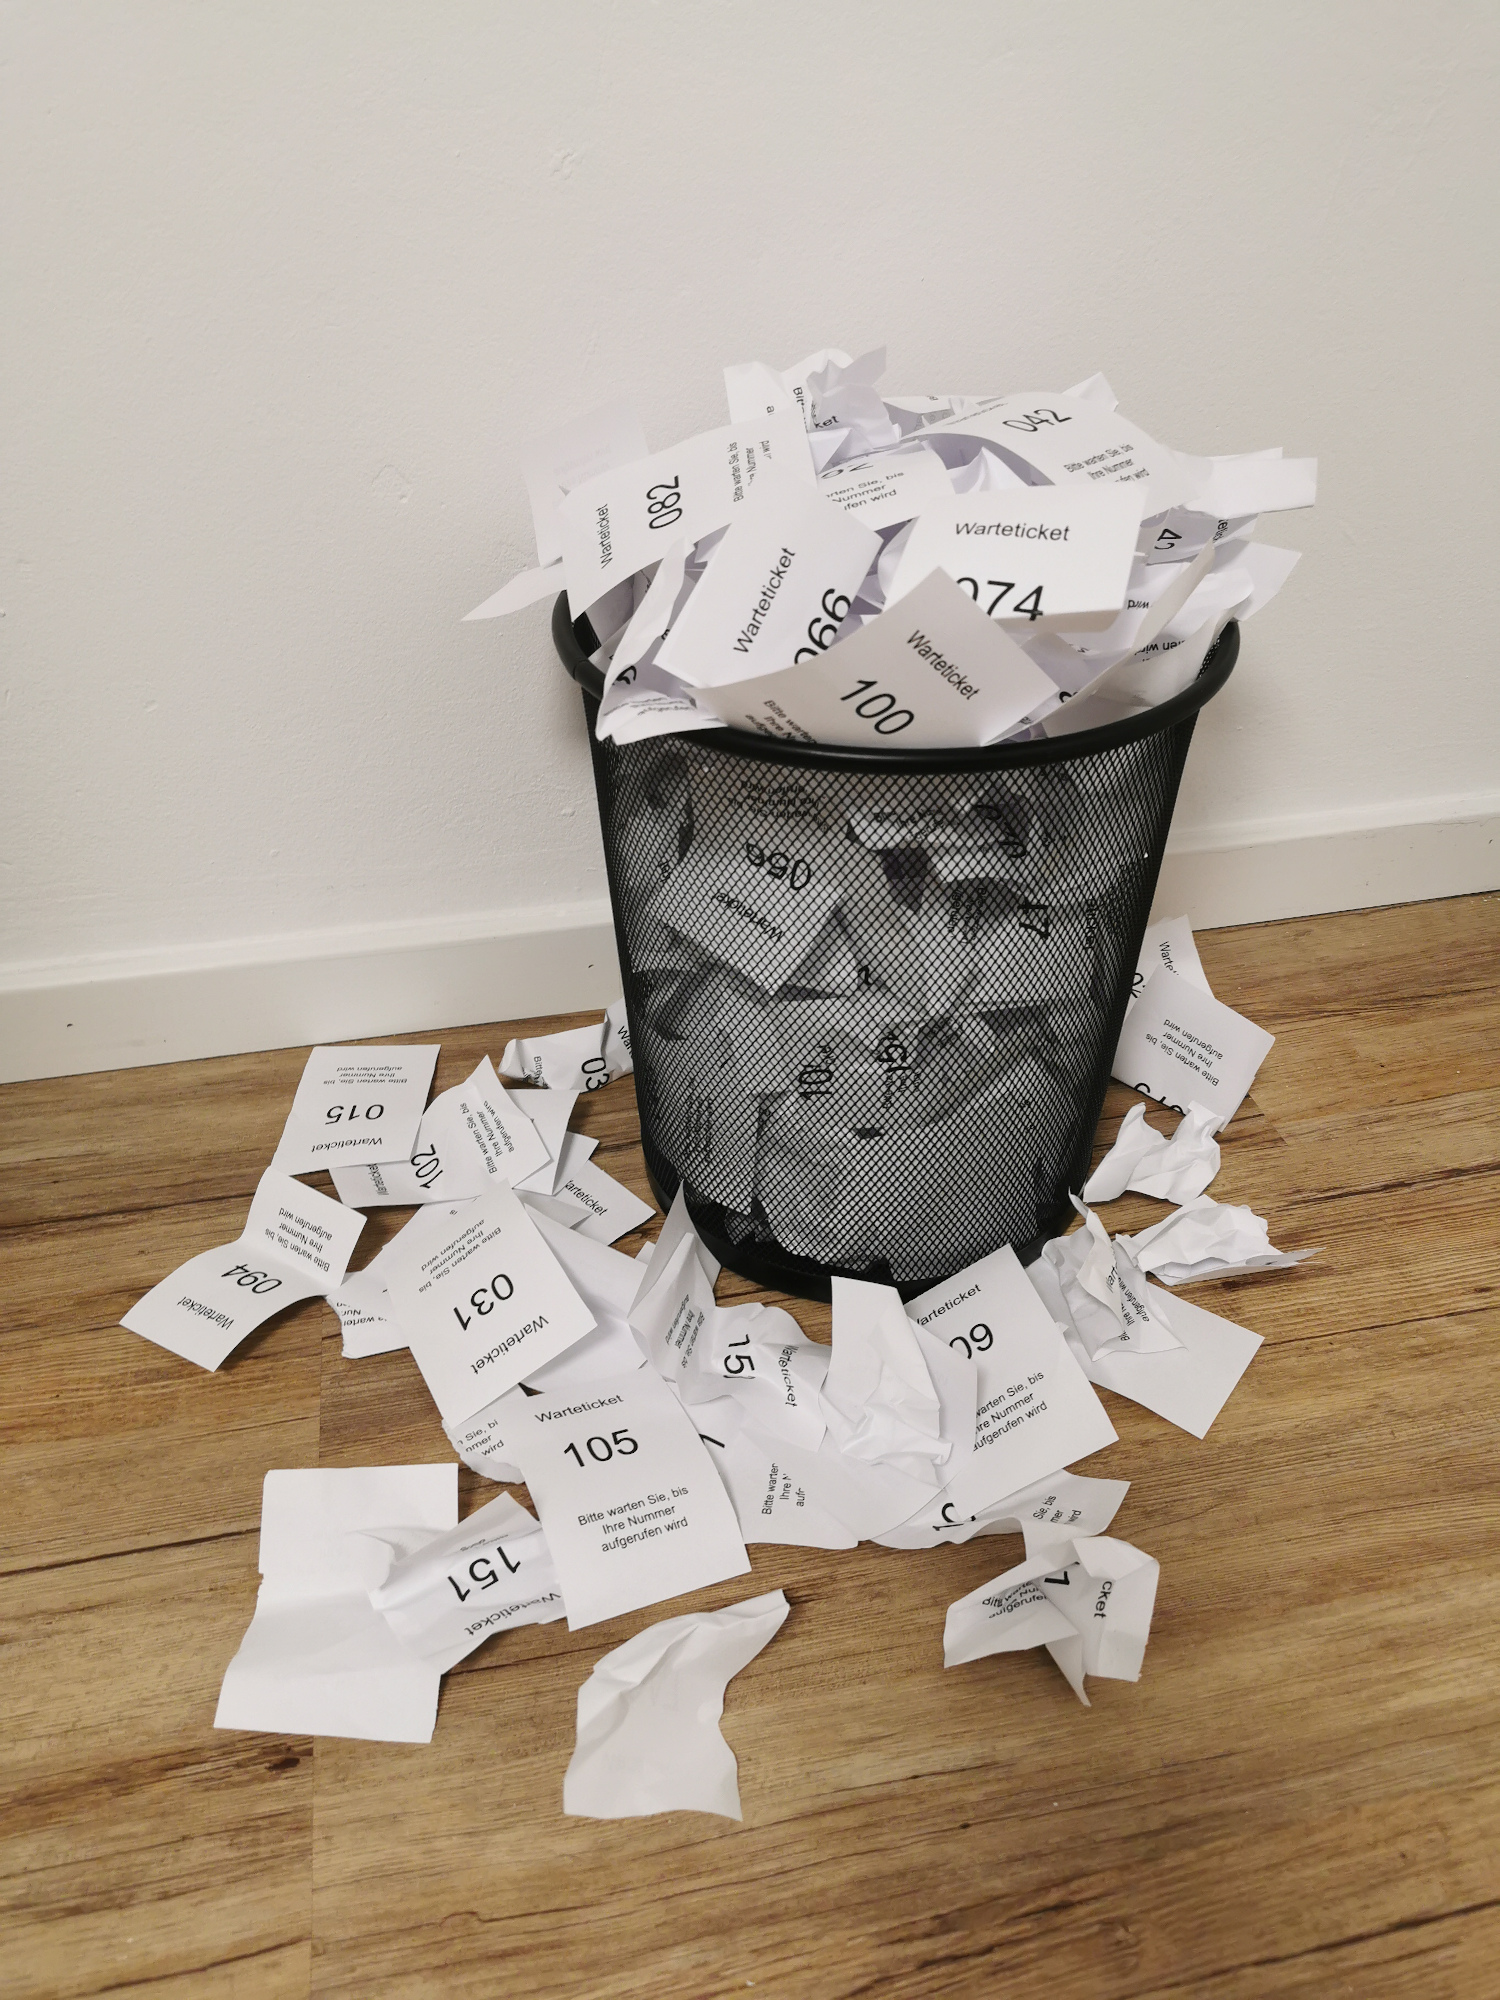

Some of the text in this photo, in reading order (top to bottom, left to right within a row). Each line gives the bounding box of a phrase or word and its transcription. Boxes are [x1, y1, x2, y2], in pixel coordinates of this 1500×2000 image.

[1002, 408, 1072, 433] 042
[886, 471, 905, 481] bis
[646, 475, 683, 530] 082
[870, 489, 897, 502] wird
[955, 522, 1071, 542] Warteticket
[733, 547, 796, 653] Warteticket
[906, 629, 980, 701] Warteticket
[840, 679, 915, 735] 100
[1145, 1032, 1158, 1045] bis
[1162, 1031, 1213, 1068] Ihre Nummer
[1163, 1018, 1224, 1060] aufgerufen wird
[581, 1056, 611, 1093] 03
[1175, 1051, 1201, 1072] warten
[1201, 1069, 1219, 1087] Bitte
[324, 1103, 385, 1126] 015
[460, 1102, 470, 1115] bis
[311, 1137, 383, 1153] Warteticket
[473, 1129, 489, 1156] warten
[476, 1110, 504, 1158] Ihre Nummer
[493, 1115, 515, 1153] aufgerufen
[411, 1143, 444, 1190] 102
[485, 1156, 498, 1174] Bitte
[264, 1228, 276, 1241] bis
[278, 1207, 333, 1240] aufgerufen wird
[279, 1221, 324, 1254] Ihre Nummer
[480, 1227, 502, 1245] Bitte
[288, 1244, 314, 1263] warten
[420, 1218, 485, 1272] aufgerufen wird
[429, 1230, 485, 1275] Ihre Nummer
[450, 1243, 481, 1268] warten
[221, 1263, 283, 1294] 094
[313, 1256, 331, 1273] Bitte
[418, 1280, 433, 1294] bis
[453, 1273, 515, 1332] 031
[177, 1296, 235, 1331] Warteticket
[1124, 1288, 1150, 1322] aufgerufen
[470, 1315, 550, 1375] Warteticket
[722, 1333, 756, 1380] 15
[1027, 1370, 1045, 1388] bis
[534, 1393, 625, 1424] Warteticket
[990, 1391, 1035, 1423] Nummer
[488, 1419, 499, 1431] bi
[973, 1401, 1048, 1453] aufgerufen wird
[481, 1440, 505, 1457] wird
[563, 1428, 639, 1468] 105
[577, 1485, 690, 1527] Bitte warten Sie, bis
[761, 1494, 772, 1515] Bitte
[1044, 1495, 1057, 1508] bis
[600, 1516, 689, 1553] aufgerufen wird
[602, 1504, 677, 1536] Ihre Nummer
[447, 1546, 522, 1602] 151
[464, 1592, 562, 1637] Warteticket
